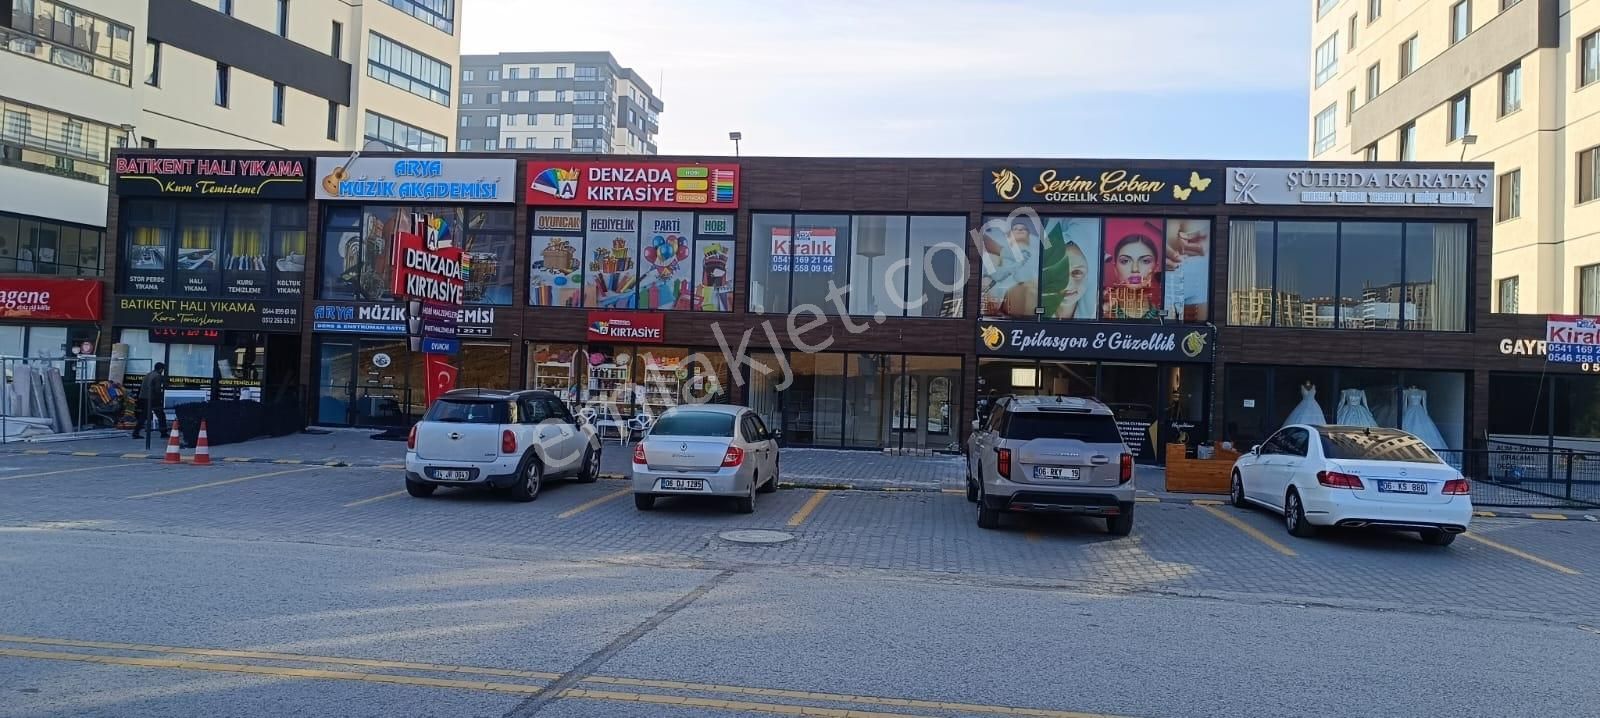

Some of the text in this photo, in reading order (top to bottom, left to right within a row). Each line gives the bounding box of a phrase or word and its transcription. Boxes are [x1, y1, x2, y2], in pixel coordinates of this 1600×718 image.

[116, 157, 304, 177] BATIKENT HALI YIKAMA
[394, 159, 443, 178] ARYA
[588, 167, 673, 183] DENZADA
[1032, 169, 1096, 194] Sevim
[1287, 170, 1489, 193] ŞÜHEDA KARATAŞ
[165, 180, 256, 195] Kuru Temizleme
[339, 179, 497, 200] MÜZİK AKADEMİSİ
[587, 184, 674, 202] KIRTASİYE
[1044, 192, 1150, 202] GÜZELLİK SALONU
[538, 216, 580, 229] OYUNCAK
[590, 217, 634, 231] HEDİYELİK
[654, 218, 680, 232] PARTİ
[704, 218, 726, 232] HOBİ
[774, 240, 832, 255] Kiralık
[406, 248, 463, 280] DENZADA
[406, 274, 464, 304] KIRTASİYE
[120, 299, 256, 313] BATIKENT HALI YIKAMA
[314, 305, 354, 320] ARYA
[359, 304, 406, 320] MÜZİK
[610, 326, 660, 338] KIRTASİYE
[1010, 329, 1176, 352] Epilasyon & Güzellik
[1548, 344, 1572, 352] 0541
[1575, 346, 1593, 354] 169
[1548, 353, 1572, 362] 0546
